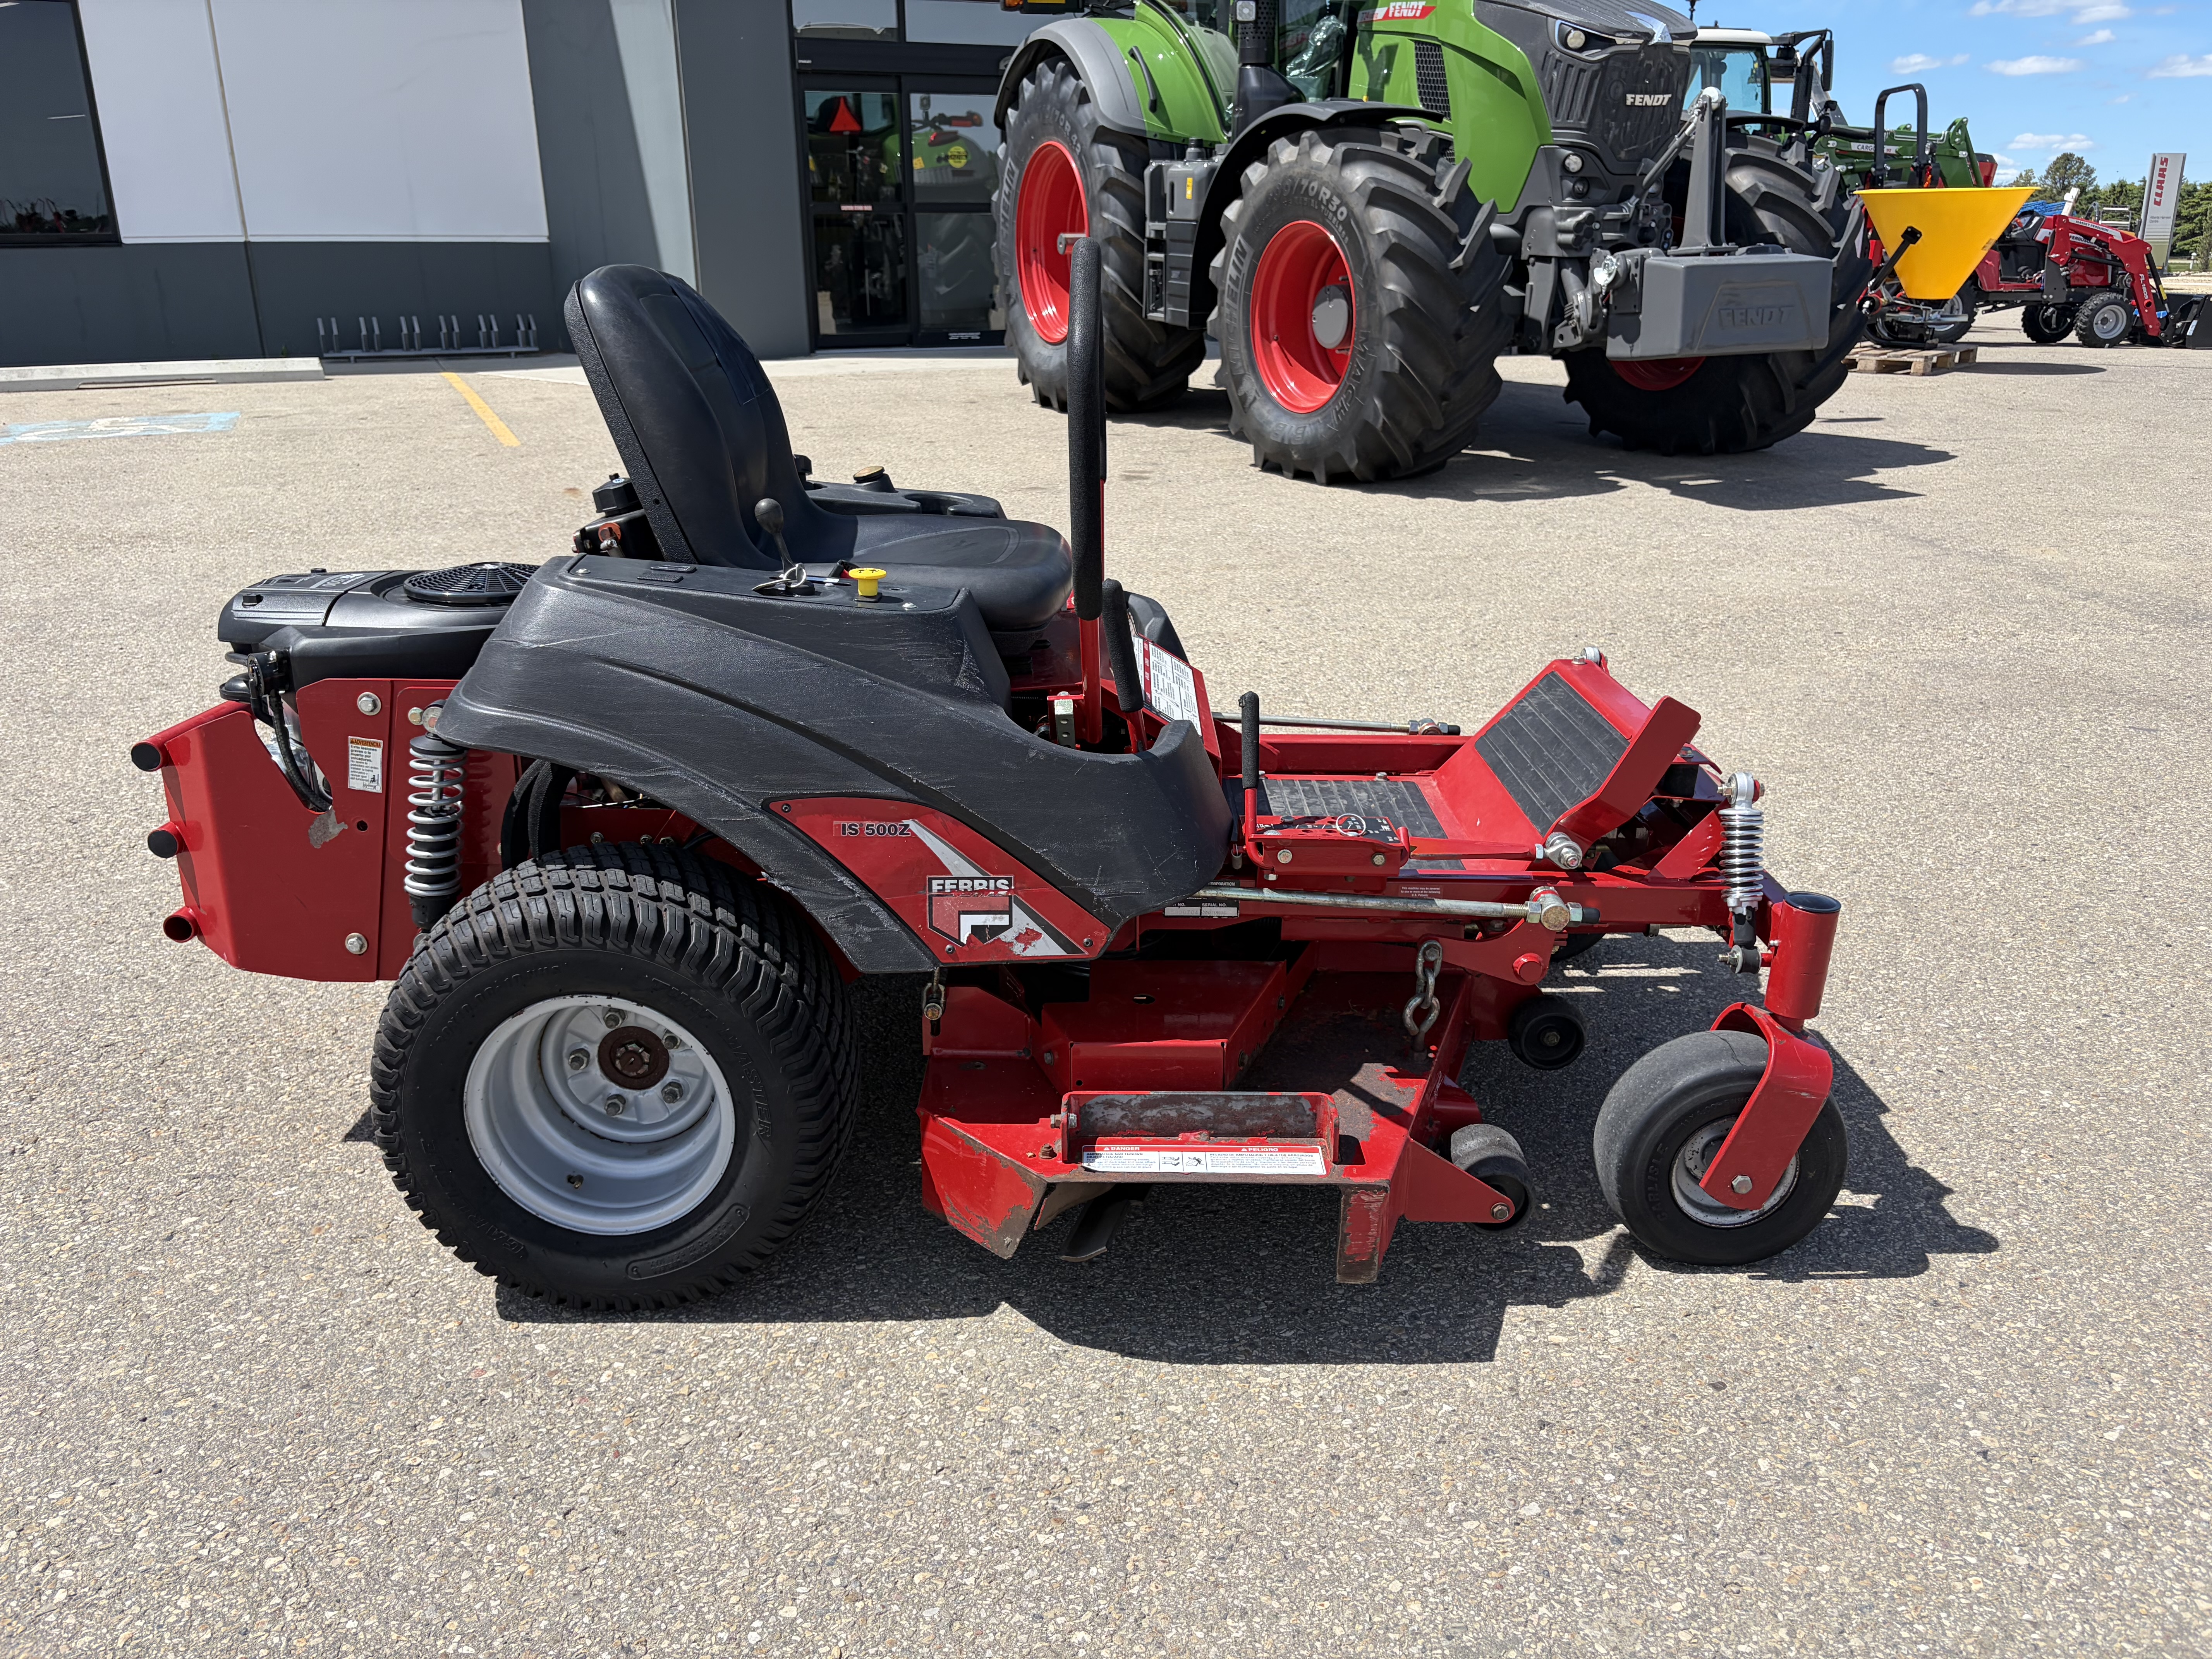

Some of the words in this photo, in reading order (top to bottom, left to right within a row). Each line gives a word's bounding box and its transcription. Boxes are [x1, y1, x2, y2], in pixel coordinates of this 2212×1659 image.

[1389, 1, 1426, 17] FENDT
[1626, 94, 1672, 106] FENDT
[2153, 156, 2169, 207] CLAAS
[2090, 223, 2109, 232] FERGUSON
[1225, 239, 1247, 374] MICHELIN
[1718, 305, 1795, 329] FENDT
[841, 823, 860, 836] IS
[864, 823, 911, 836] 500Z
[932, 879, 1009, 893] FERRIS
[719, 1028, 772, 1138] MASTER
[1647, 1143, 1668, 1220] CARLISLE
[420, 1139, 524, 1254] CARLISLE
